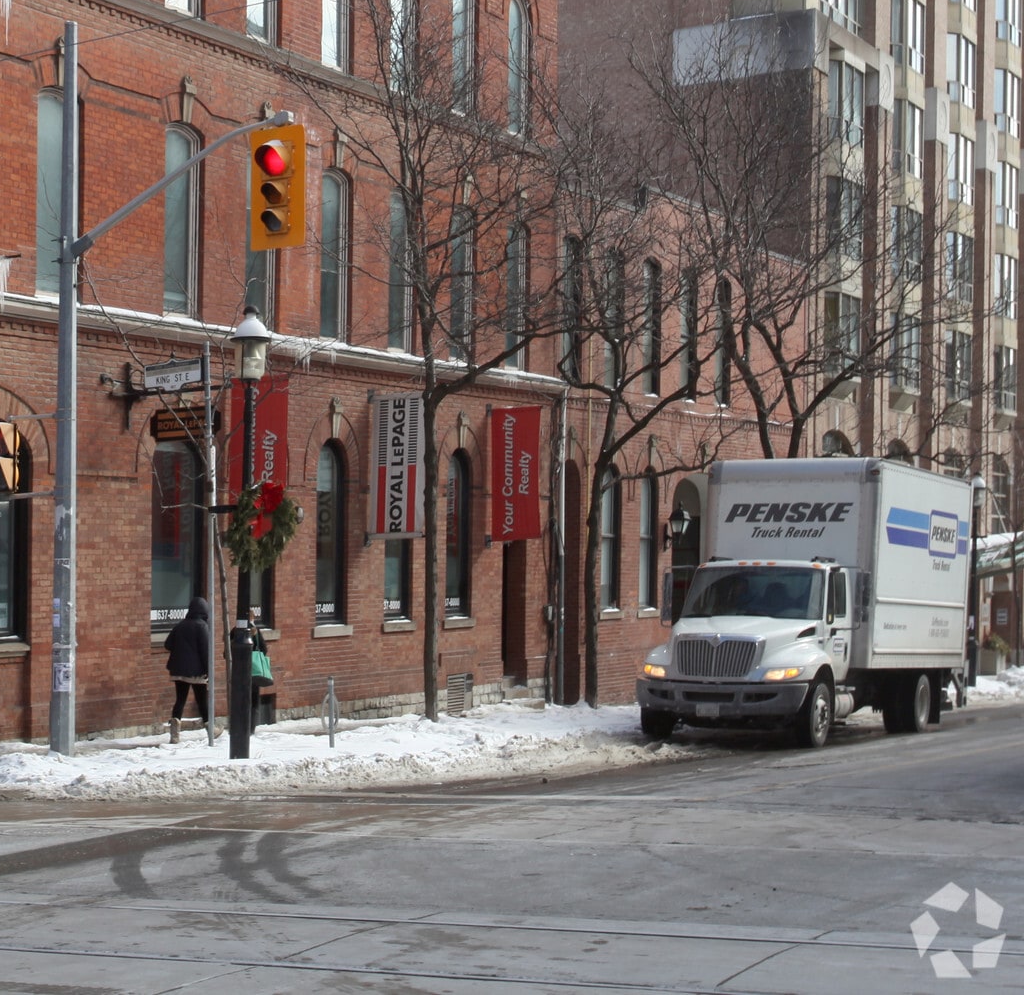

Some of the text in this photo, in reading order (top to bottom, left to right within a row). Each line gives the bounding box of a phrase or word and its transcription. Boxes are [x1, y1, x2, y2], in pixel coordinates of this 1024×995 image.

[156, 375, 171, 385] KING
[185, 372, 190, 381] E
[261, 429, 278, 484] Realty
[502, 413, 517, 535] Your Community
[519, 451, 532, 495] Realty
[389, 470, 404, 533] ROYAL
[724, 502, 854, 523] PENSKE
[751, 526, 826, 538] Truck Rental
[931, 525, 956, 543] PENSKE
